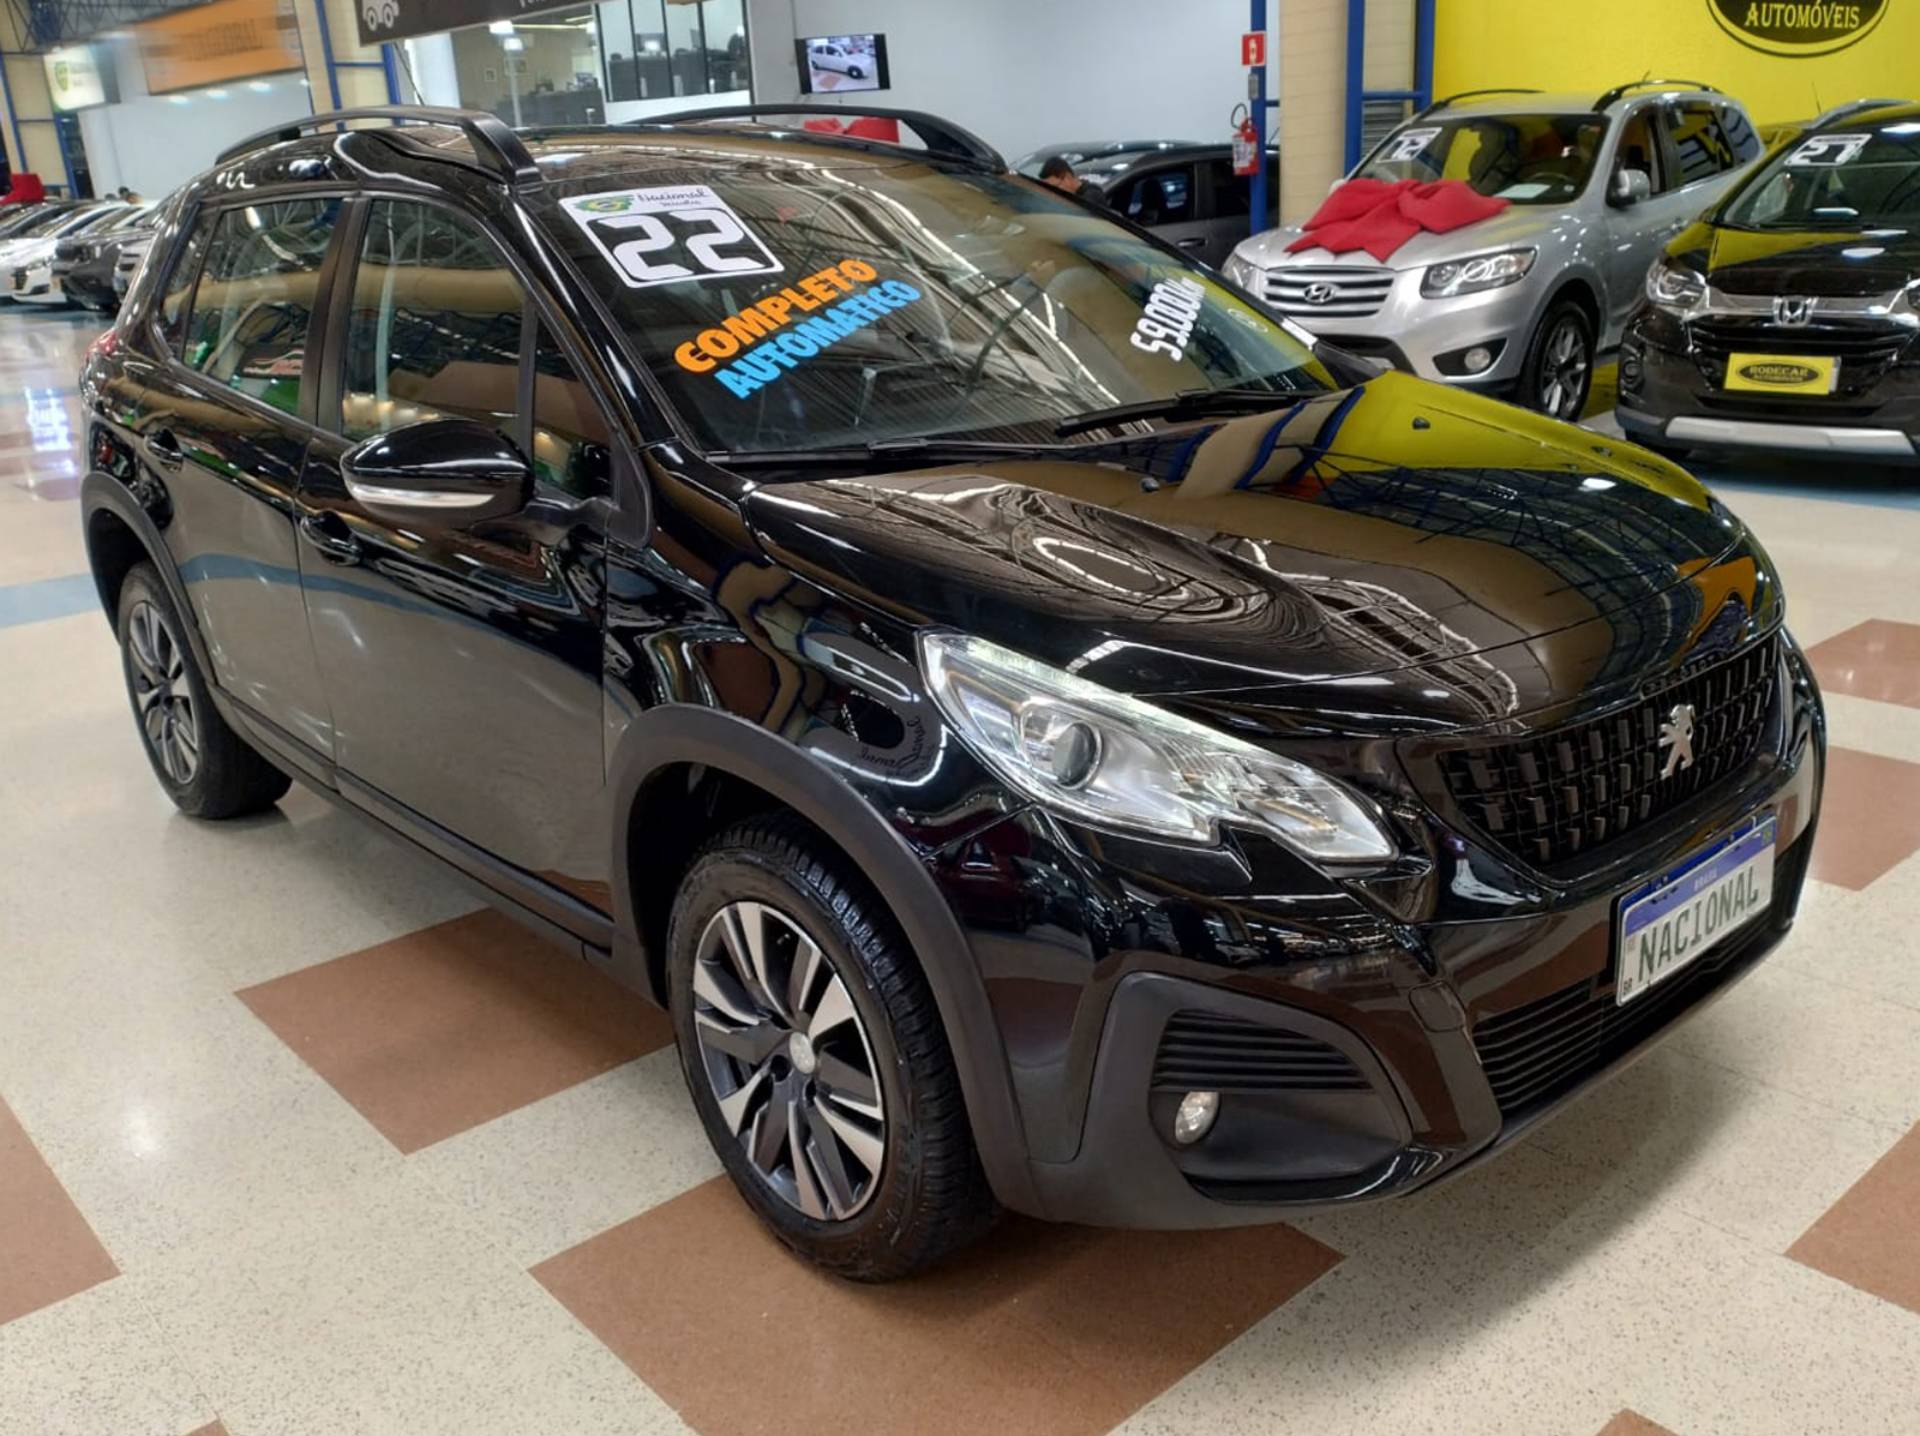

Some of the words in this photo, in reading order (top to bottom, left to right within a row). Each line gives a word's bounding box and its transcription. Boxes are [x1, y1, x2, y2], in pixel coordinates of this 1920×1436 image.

[1744, 0, 1861, 29] AUTOMÓVEIS
[597, 209, 767, 281] 22
[674, 258, 878, 374] COMPLETO
[714, 279, 922, 400] AUTOMATICO
[1638, 865, 1759, 982] NACIONAL
